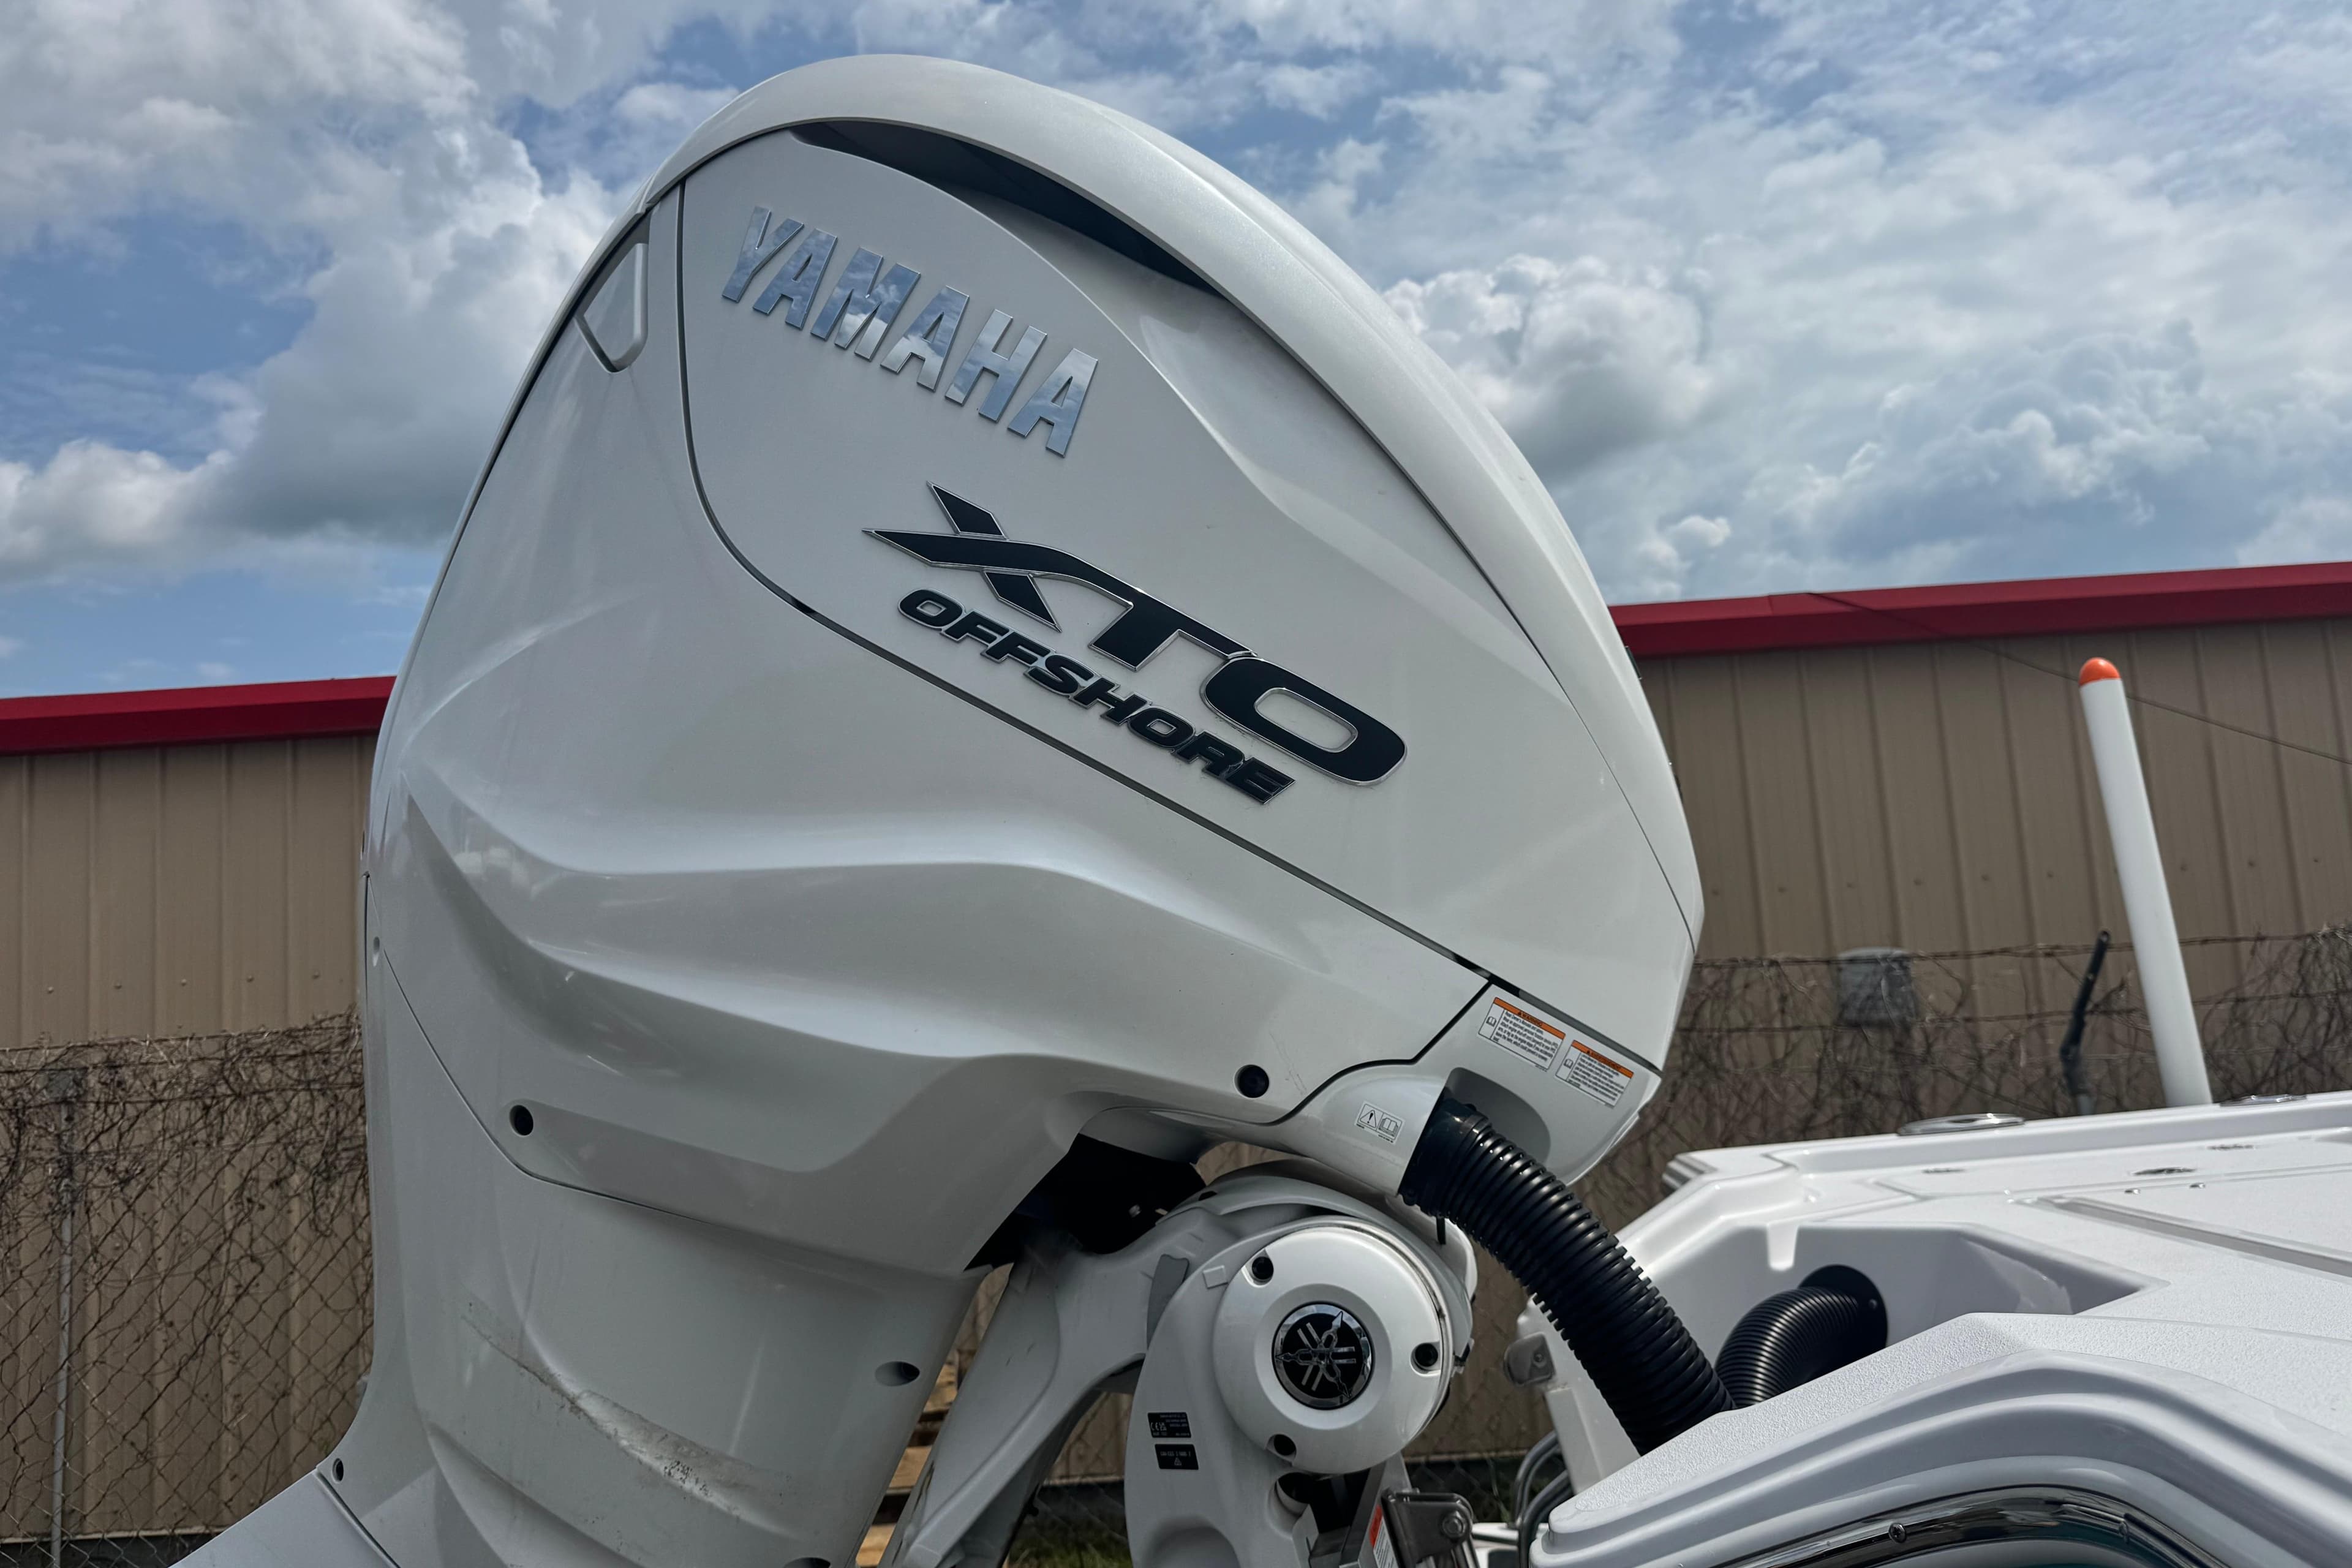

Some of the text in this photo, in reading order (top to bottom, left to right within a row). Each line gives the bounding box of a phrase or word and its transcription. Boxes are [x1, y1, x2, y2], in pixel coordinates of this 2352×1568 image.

[722, 206, 1099, 458] YAMAHA
[862, 481, 1408, 788] XTO
[898, 588, 1296, 805] OFFSHORE
